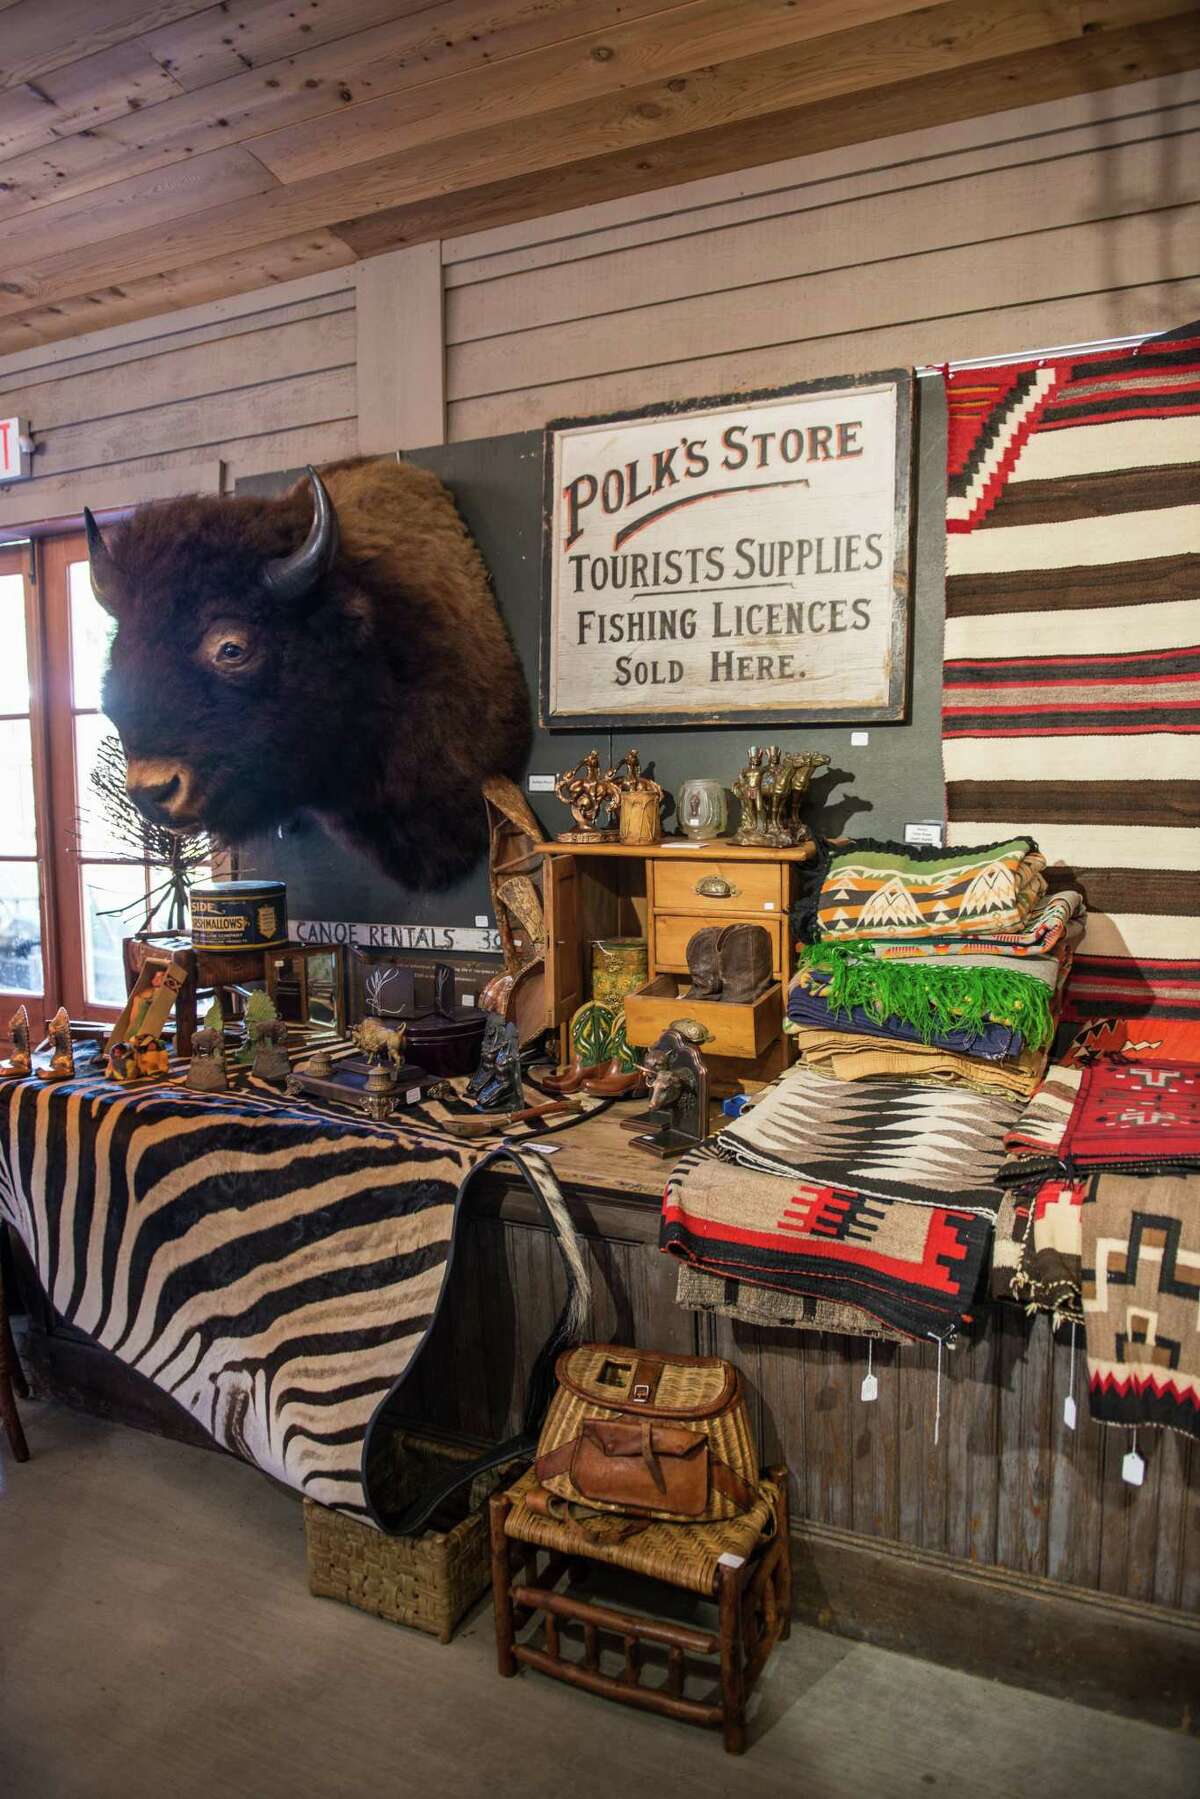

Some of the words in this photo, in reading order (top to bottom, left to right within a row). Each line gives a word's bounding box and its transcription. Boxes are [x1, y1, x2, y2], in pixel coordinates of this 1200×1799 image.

[564, 438, 709, 551] POLK'S
[721, 421, 864, 470] STORE
[568, 545, 725, 593] TOURISTS
[732, 533, 883, 580] SUPPLIES
[577, 608, 698, 645] FISHING
[712, 598, 872, 638] LICENCES
[614, 656, 685, 686] SOLD
[710, 650, 807, 682] HERE.
[296, 922, 359, 945] CANOE
[369, 925, 455, 949] RENTALS
